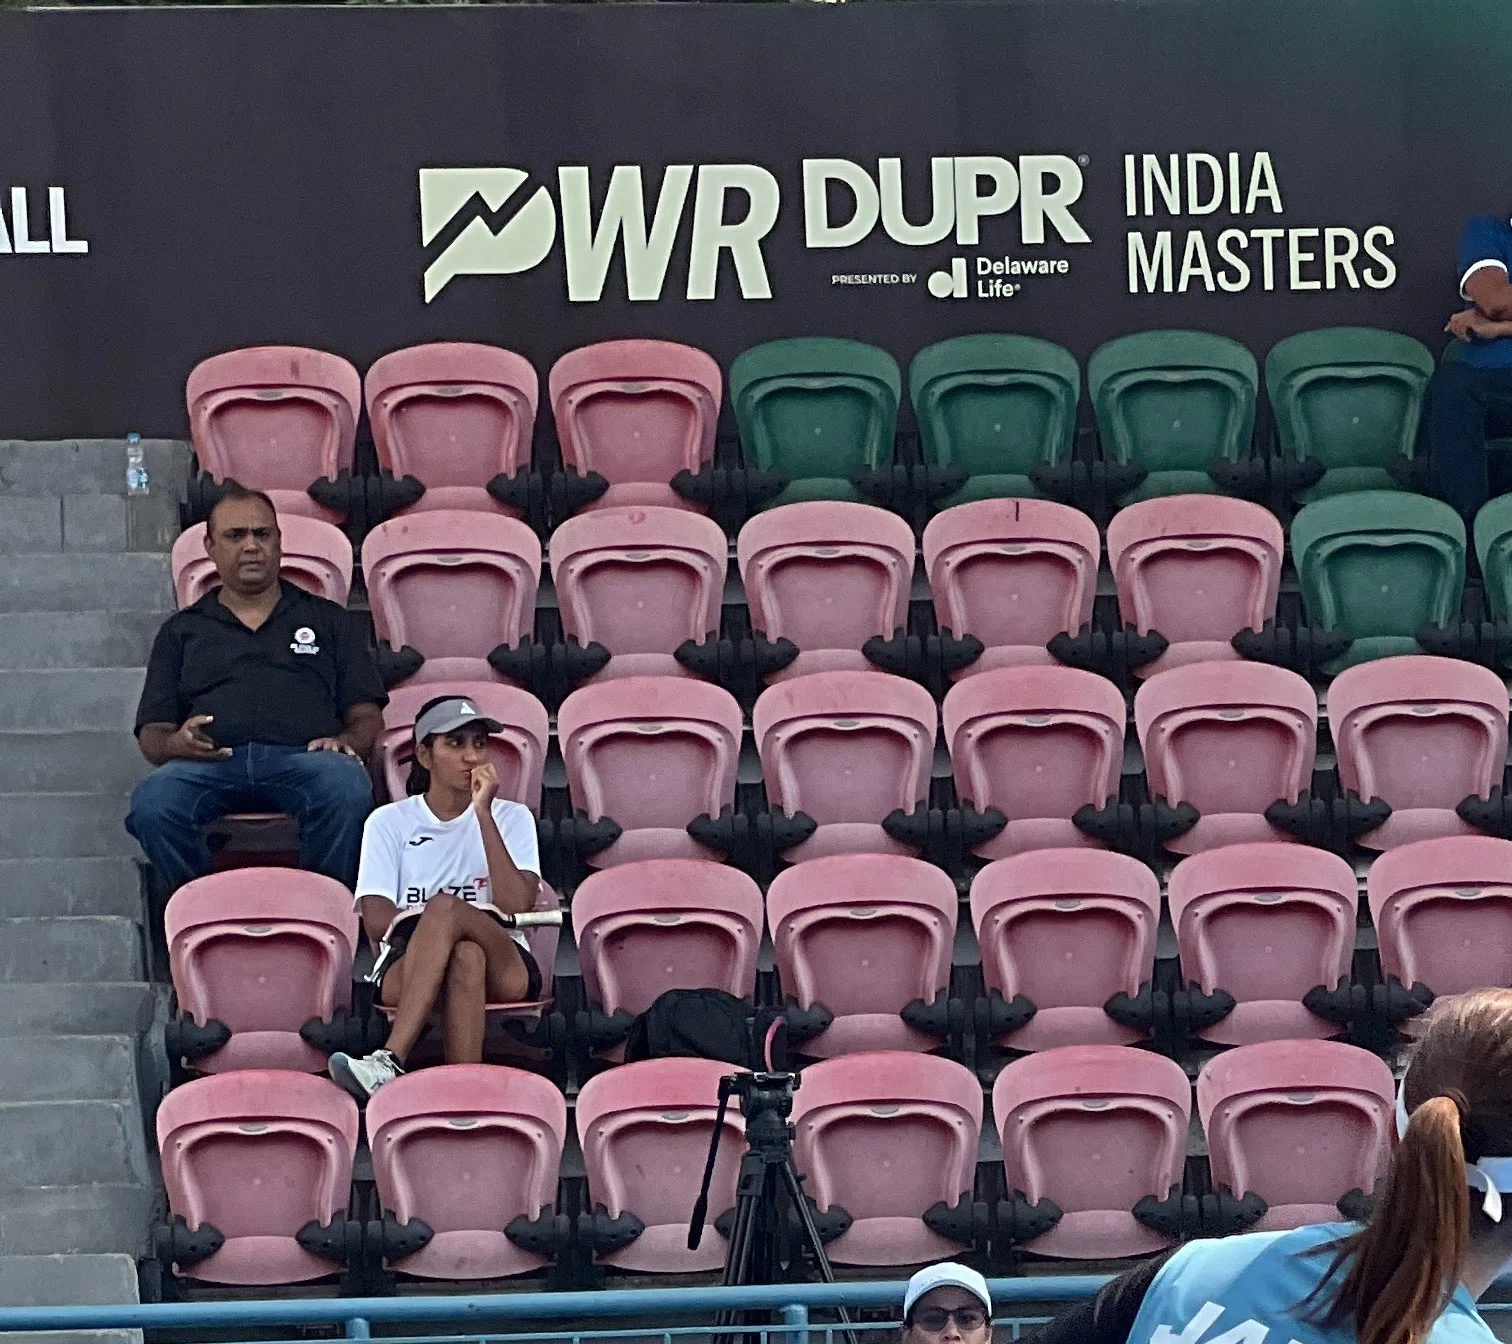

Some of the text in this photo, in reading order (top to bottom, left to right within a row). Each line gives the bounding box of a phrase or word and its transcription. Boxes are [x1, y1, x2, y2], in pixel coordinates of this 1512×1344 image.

[1124, 151, 1284, 217] INDIA
[802, 155, 1092, 248] DUPR
[976, 255, 1069, 275] Delaware
[1127, 225, 1397, 293] MASTERS
[831, 273, 917, 285] PRESENTED BY
[977, 279, 1014, 298] Life
[407, 885, 477, 903] BLZE
